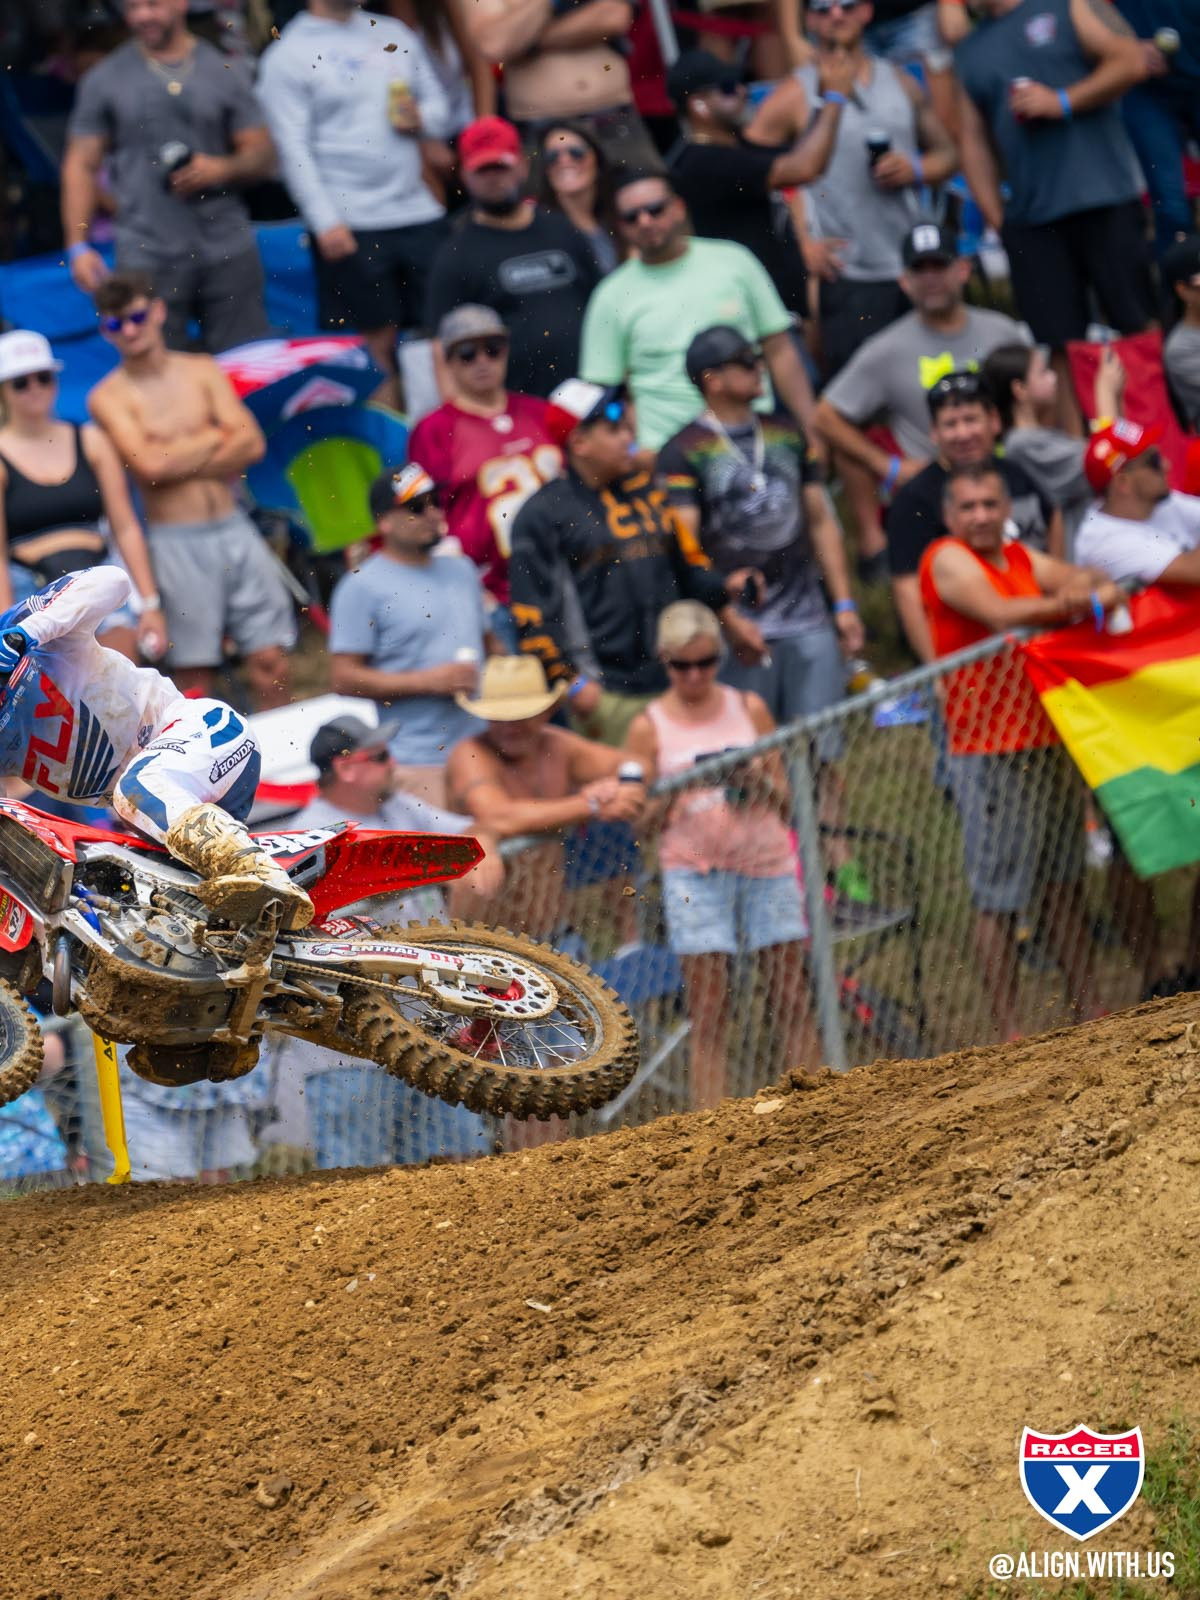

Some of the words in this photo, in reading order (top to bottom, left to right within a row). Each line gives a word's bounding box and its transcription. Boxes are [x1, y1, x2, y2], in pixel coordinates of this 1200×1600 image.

[477, 443, 564, 560] 2
[22, 672, 74, 794] FLY
[218, 741, 255, 777] HONDA
